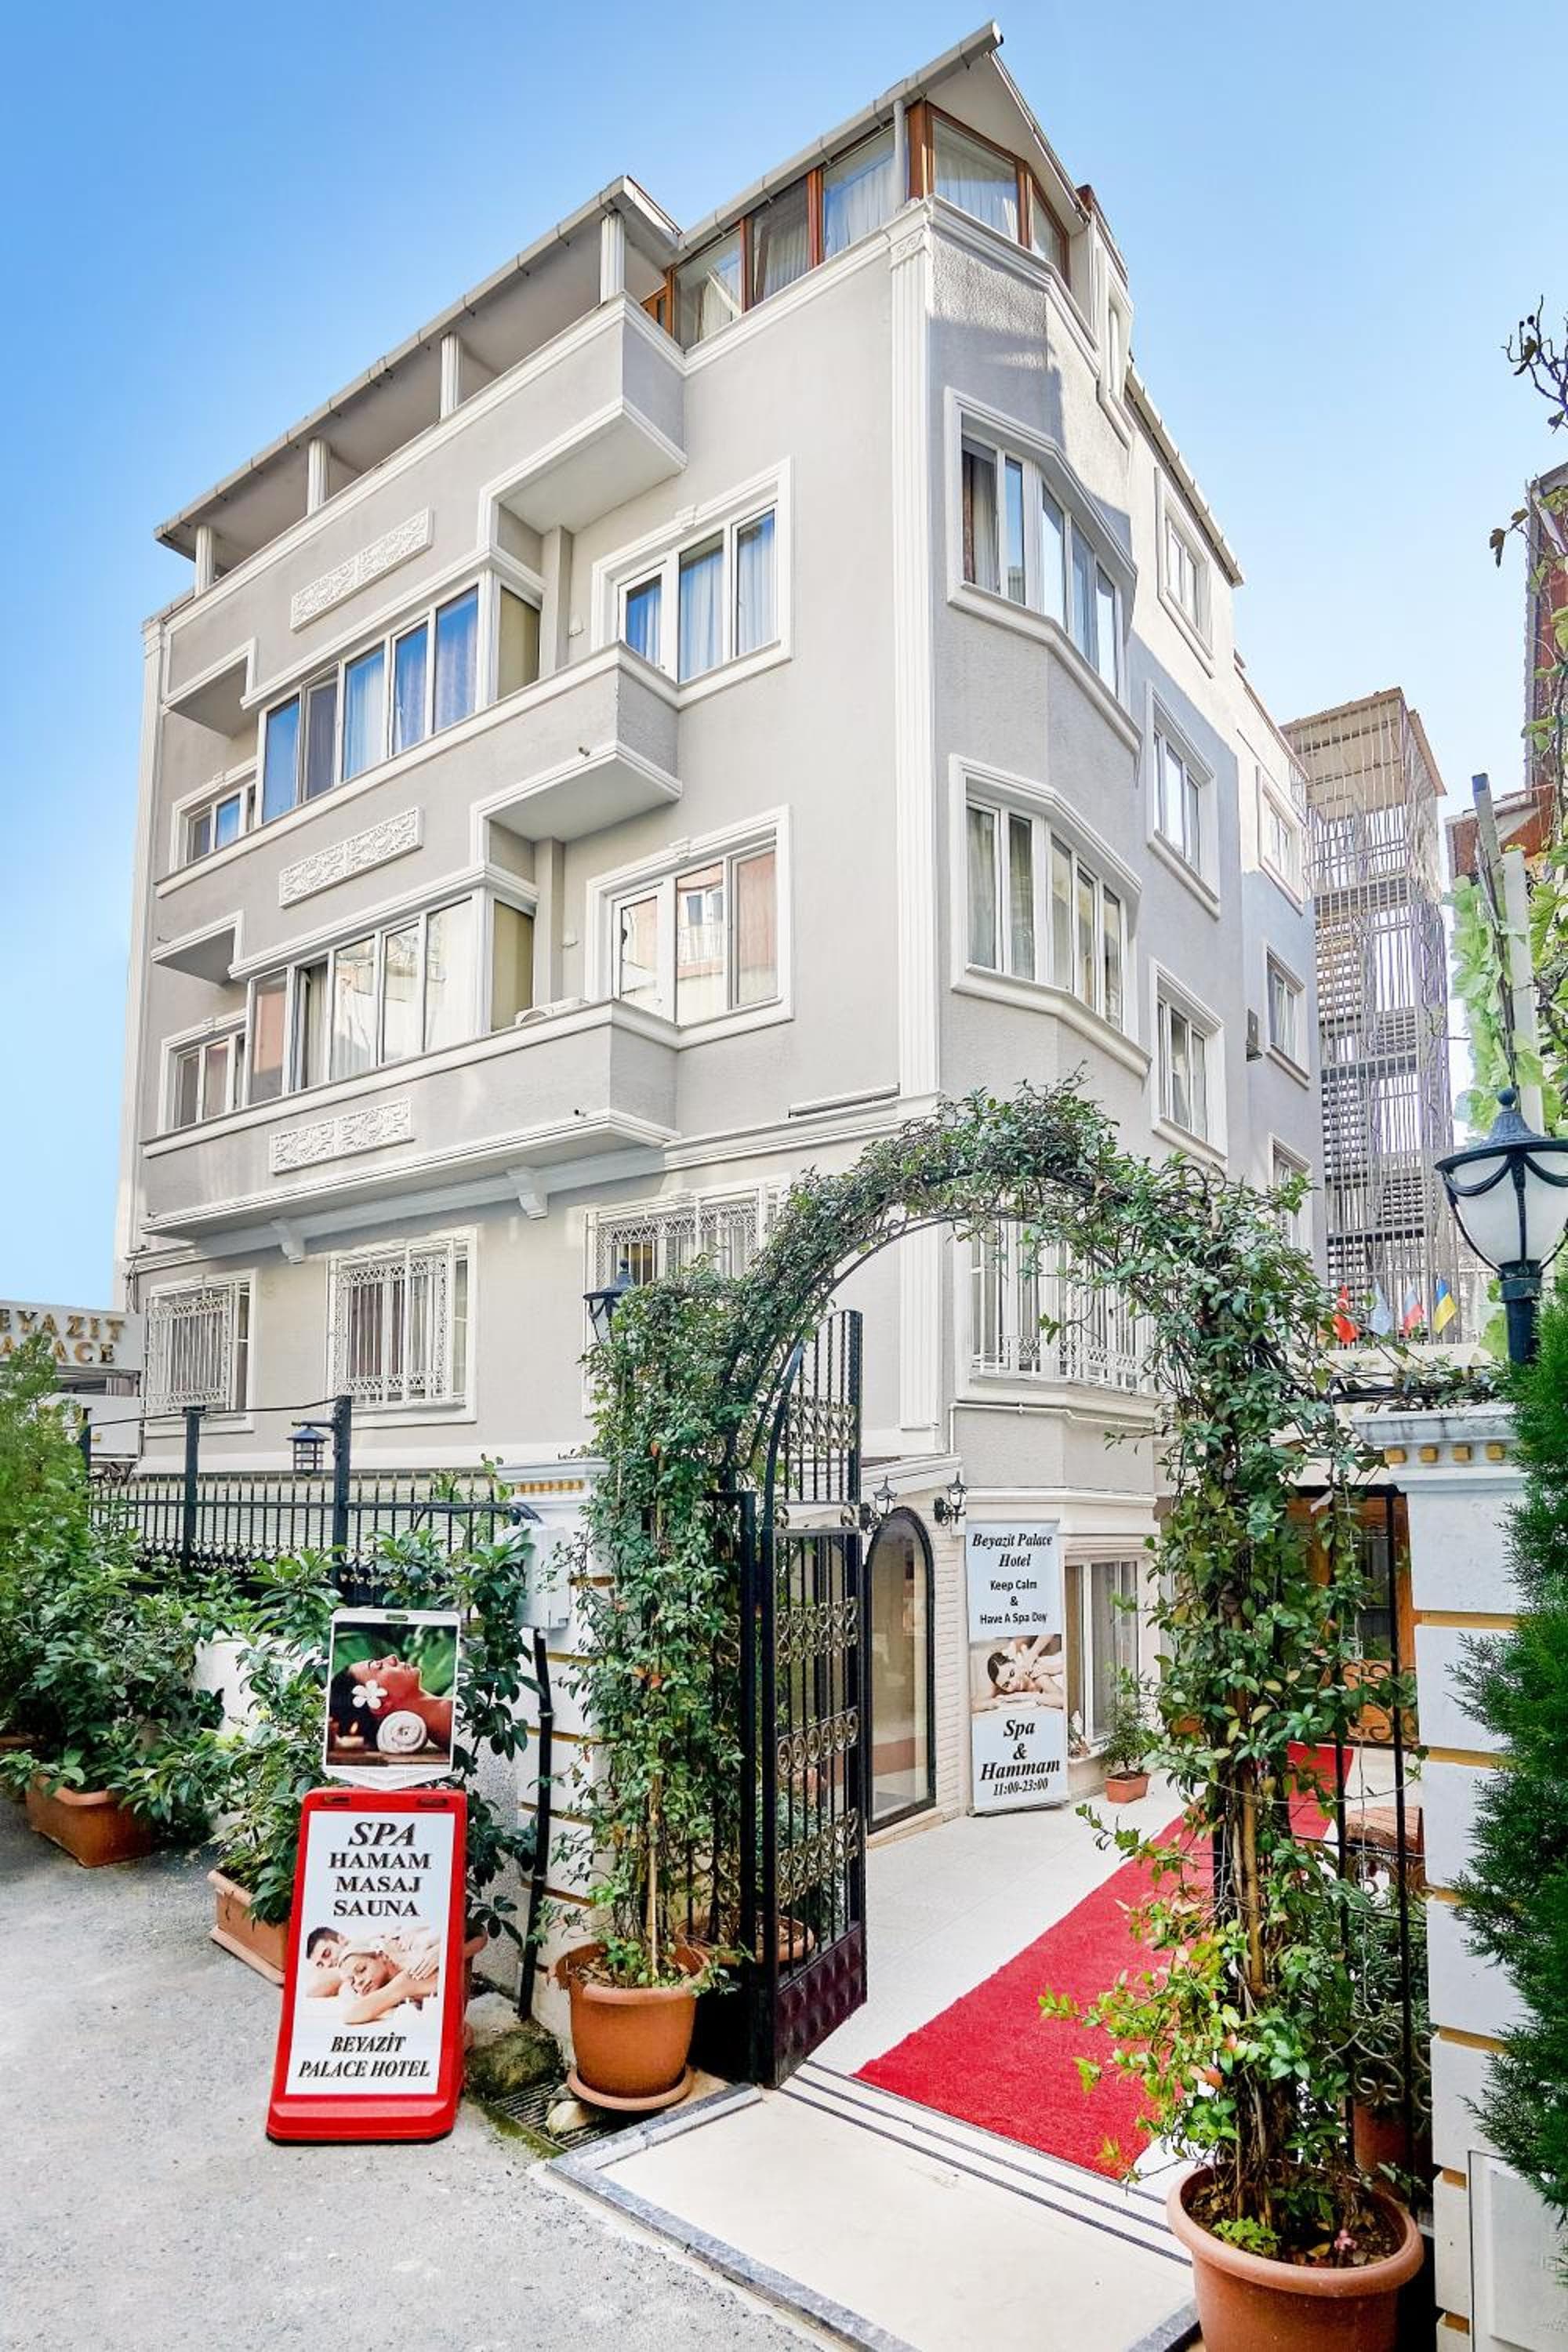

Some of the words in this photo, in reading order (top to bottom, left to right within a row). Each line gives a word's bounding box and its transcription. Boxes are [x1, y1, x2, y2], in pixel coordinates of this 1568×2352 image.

[1, 1335, 114, 1365] AACE
[1018, 1533, 1053, 1547] Palace
[998, 1554, 1031, 1567] Hotel
[990, 1580, 1014, 1592] Keep
[1015, 1578, 1037, 1589] Calm
[1010, 1595, 1018, 1606] &
[979, 1614, 1003, 1624] Have
[1004, 1613, 1011, 1623] A
[1012, 1612, 1030, 1624] Spa
[1032, 1611, 1047, 1623] Day
[1004, 1719, 1035, 1740] Spa
[1012, 1743, 1027, 1760] &
[979, 1760, 1060, 1781] Hammam
[993, 1777, 1049, 1796] 11:00-23:00
[348, 1821, 416, 1846] SPA
[328, 1852, 431, 1870] HAMAM
[335, 1876, 423, 1893] MASAJ
[332, 1900, 420, 1917] SAUNA
[298, 2061, 368, 2078] PALACE
[370, 2060, 430, 2078] HOTEL
